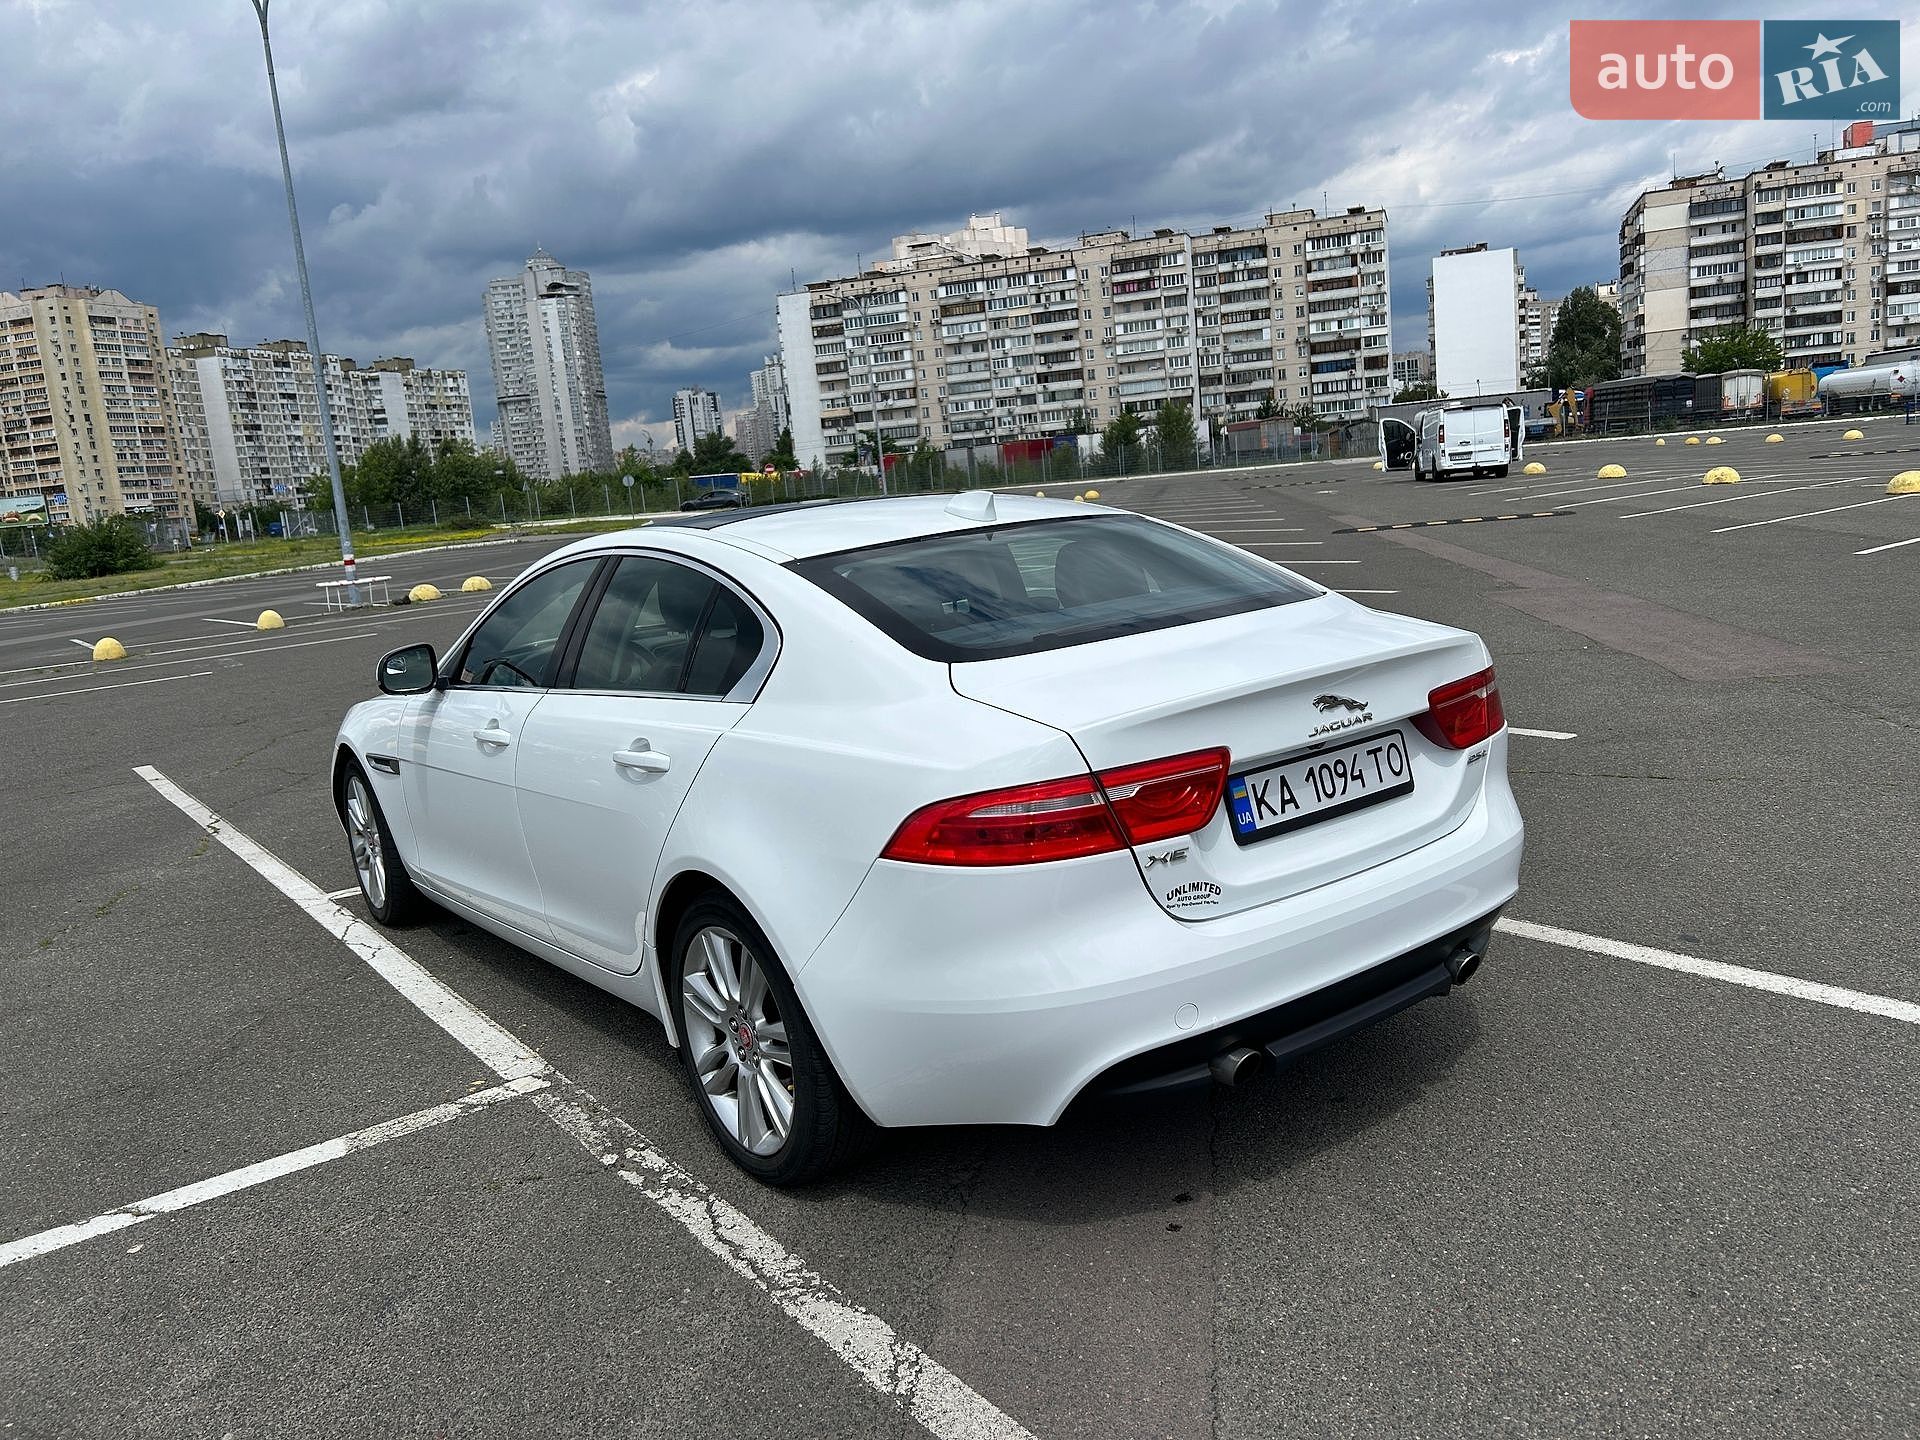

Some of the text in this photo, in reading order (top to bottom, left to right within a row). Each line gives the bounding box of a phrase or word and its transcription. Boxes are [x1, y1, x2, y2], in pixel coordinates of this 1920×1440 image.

[1308, 712, 1373, 738] JAGUAR
[1253, 742, 1403, 821] KA 1094 TO
[1238, 812, 1253, 826] UA
[1145, 847, 1190, 868] XE
[1166, 881, 1222, 901] UNLIMITED
[1192, 893, 1211, 901] GROUP
